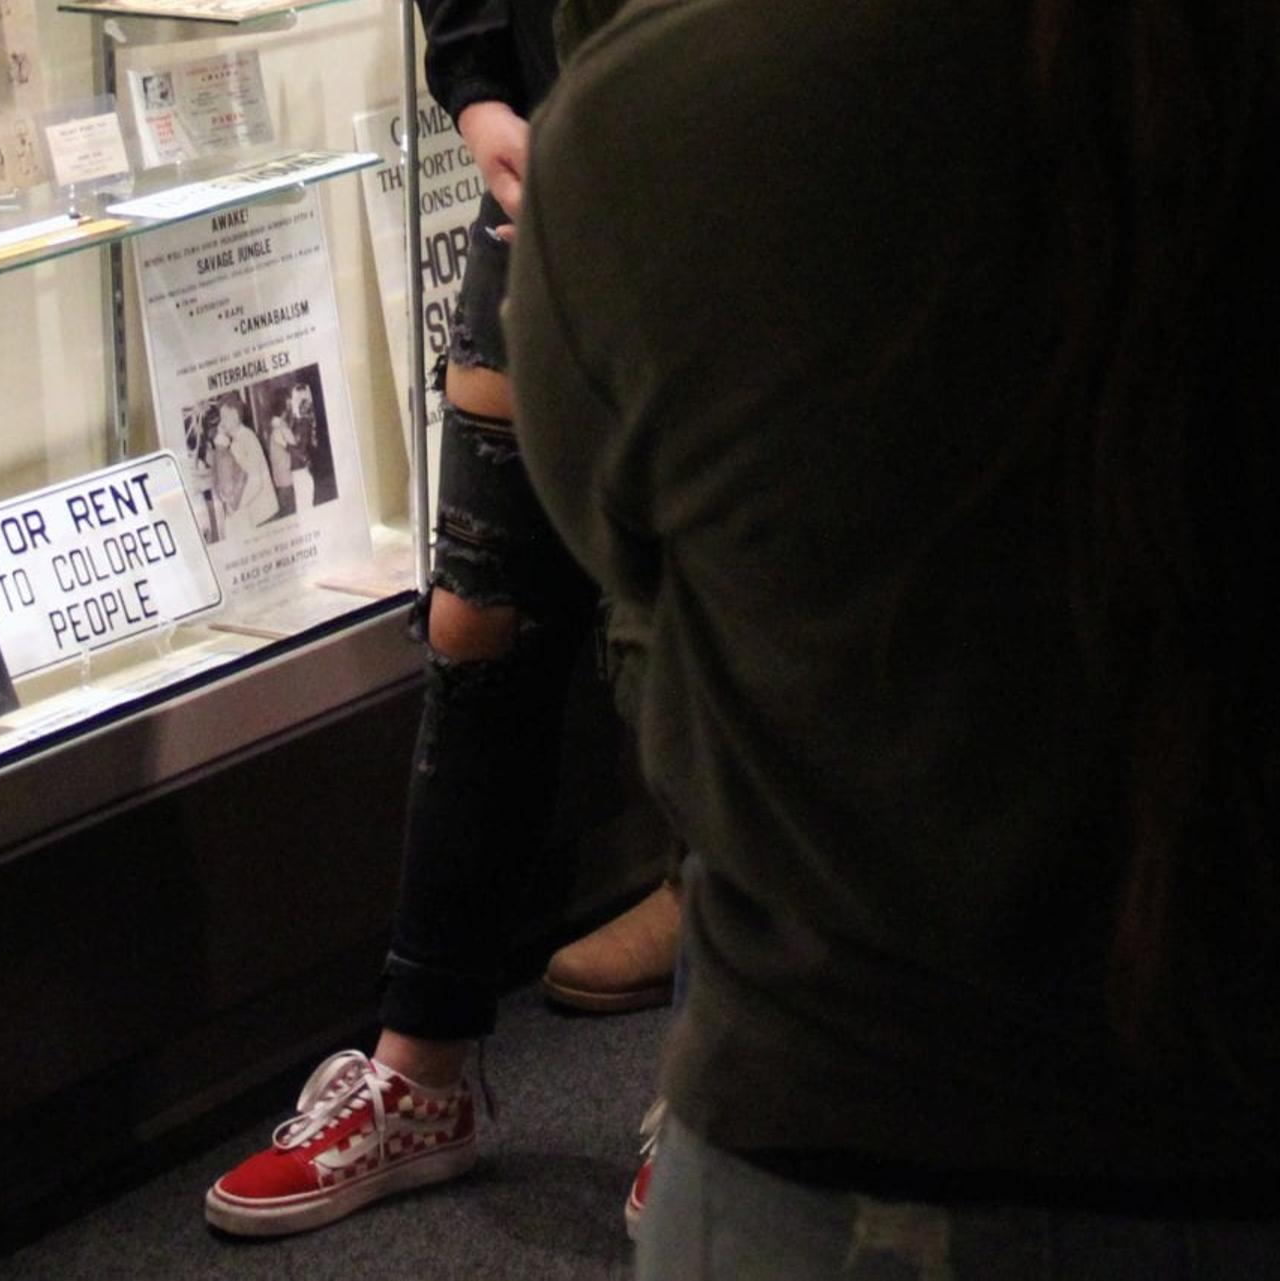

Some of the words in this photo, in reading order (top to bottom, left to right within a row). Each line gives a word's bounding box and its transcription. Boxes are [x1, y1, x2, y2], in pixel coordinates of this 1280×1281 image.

[211, 207, 249, 232] AWAKE!
[197, 248, 234, 274] SAVAGE
[238, 237, 272, 263] JUNGLE
[240, 299, 310, 336] CANNABALISM
[207, 357, 269, 391] INTERRACIAL
[271, 351, 291, 370] SEX
[66, 472, 153, 535] RENT
[52, 520, 177, 593] COLORED
[49, 579, 158, 650] PEOPLE
